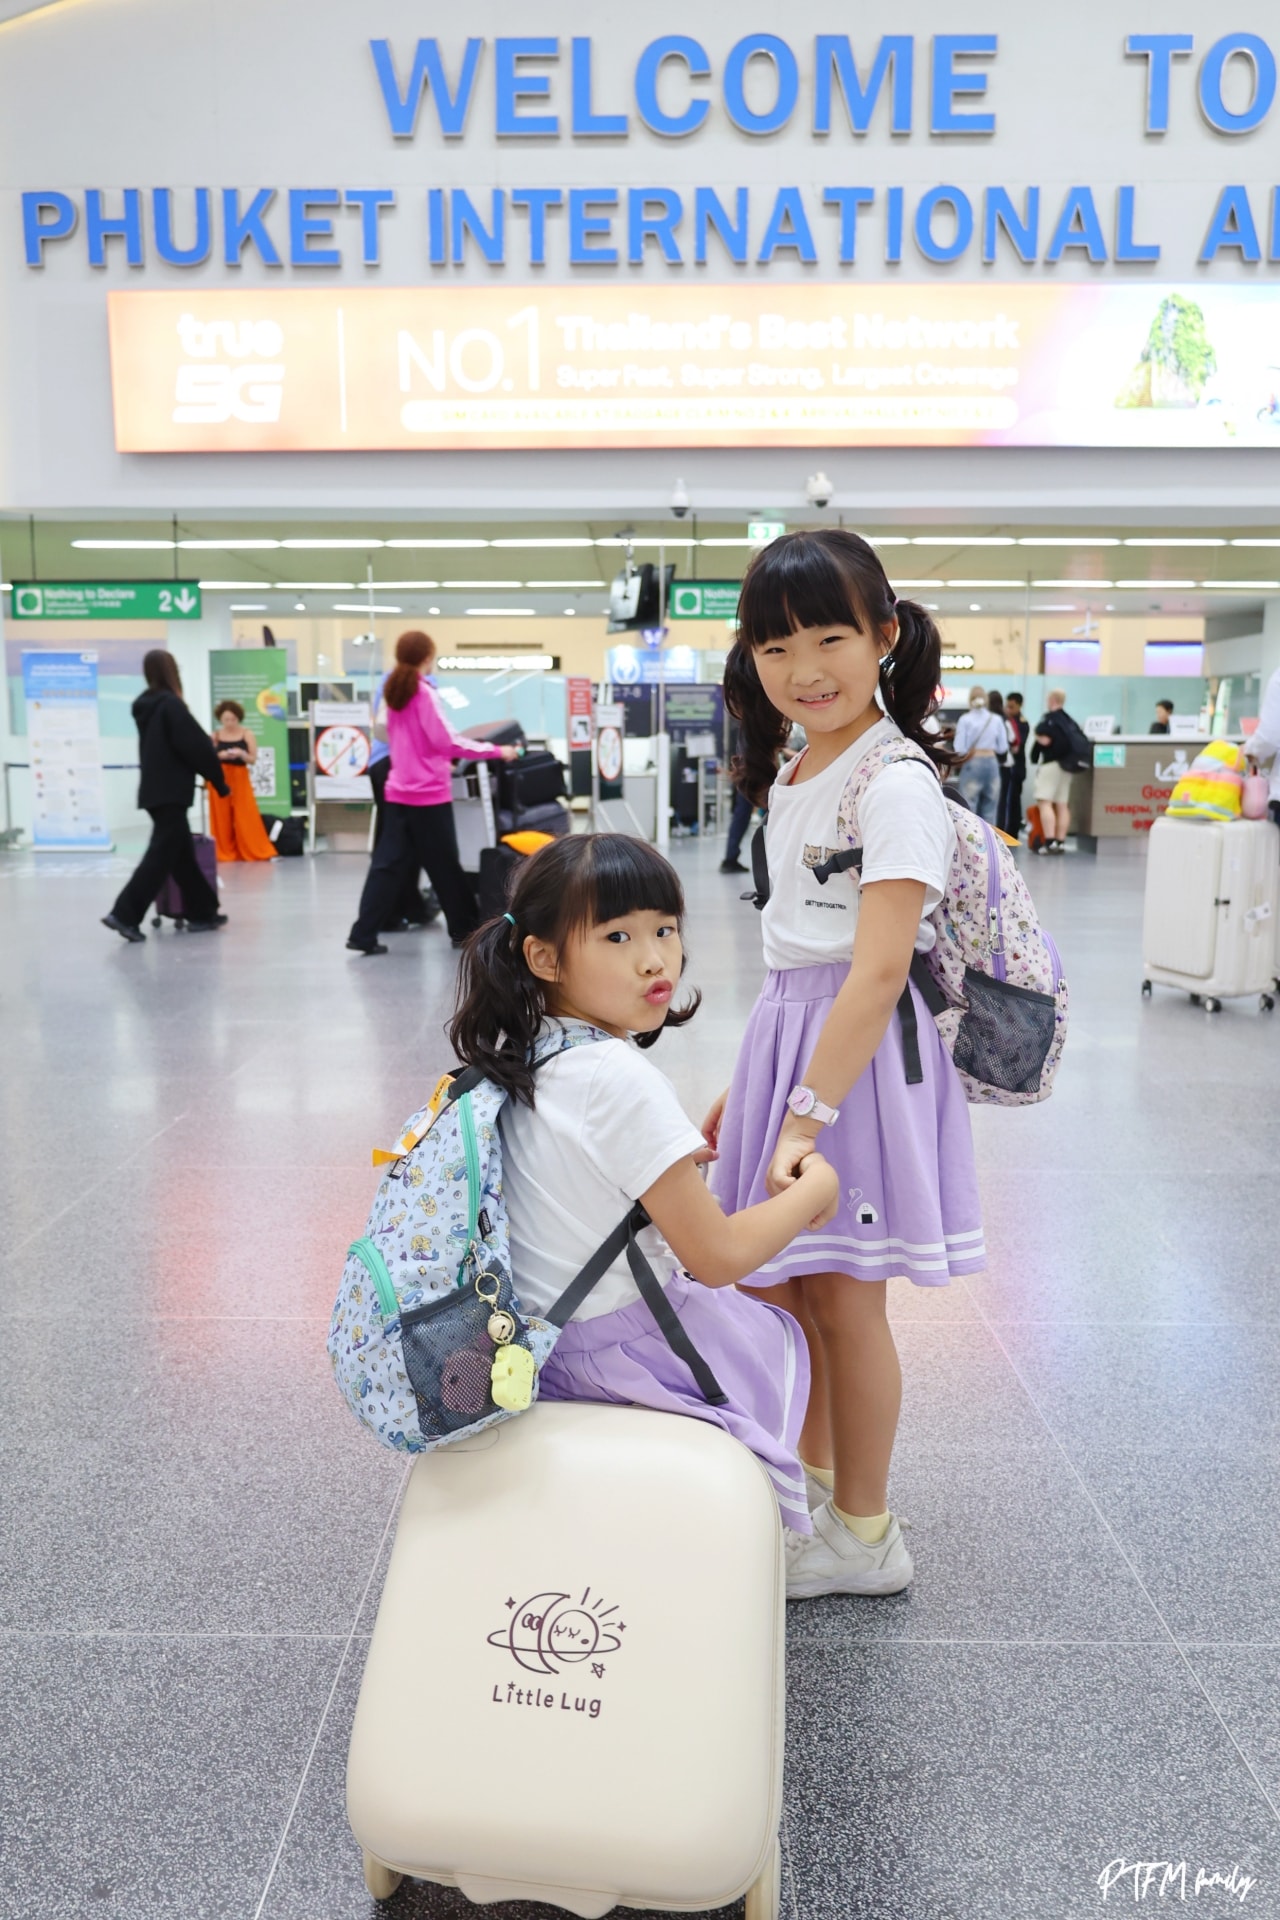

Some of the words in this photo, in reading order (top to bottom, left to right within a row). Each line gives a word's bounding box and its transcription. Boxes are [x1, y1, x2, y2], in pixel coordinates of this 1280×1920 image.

[369, 33, 999, 138] WELCOME
[1126, 32, 1278, 135] TO
[21, 187, 396, 267] PHUKET
[428, 184, 1162, 265] INTERNATIONAL
[176, 313, 284, 358] true
[397, 305, 541, 392] NO.1
[556, 313, 752, 350] Thailand's
[758, 313, 848, 350] Best
[853, 312, 1020, 349] Network
[172, 364, 285, 423] 5G
[557, 363, 621, 390] Super
[681, 362, 745, 389] Super
[832, 362, 912, 390] Largest
[914, 362, 1019, 390] Coverage
[44, 588, 84, 601] Nothing
[85, 588, 96, 599] to
[97, 587, 136, 599] Declare
[158, 590, 172, 612] 2
[492, 1681, 554, 1708] Little
[561, 1692, 602, 1719] Lug
